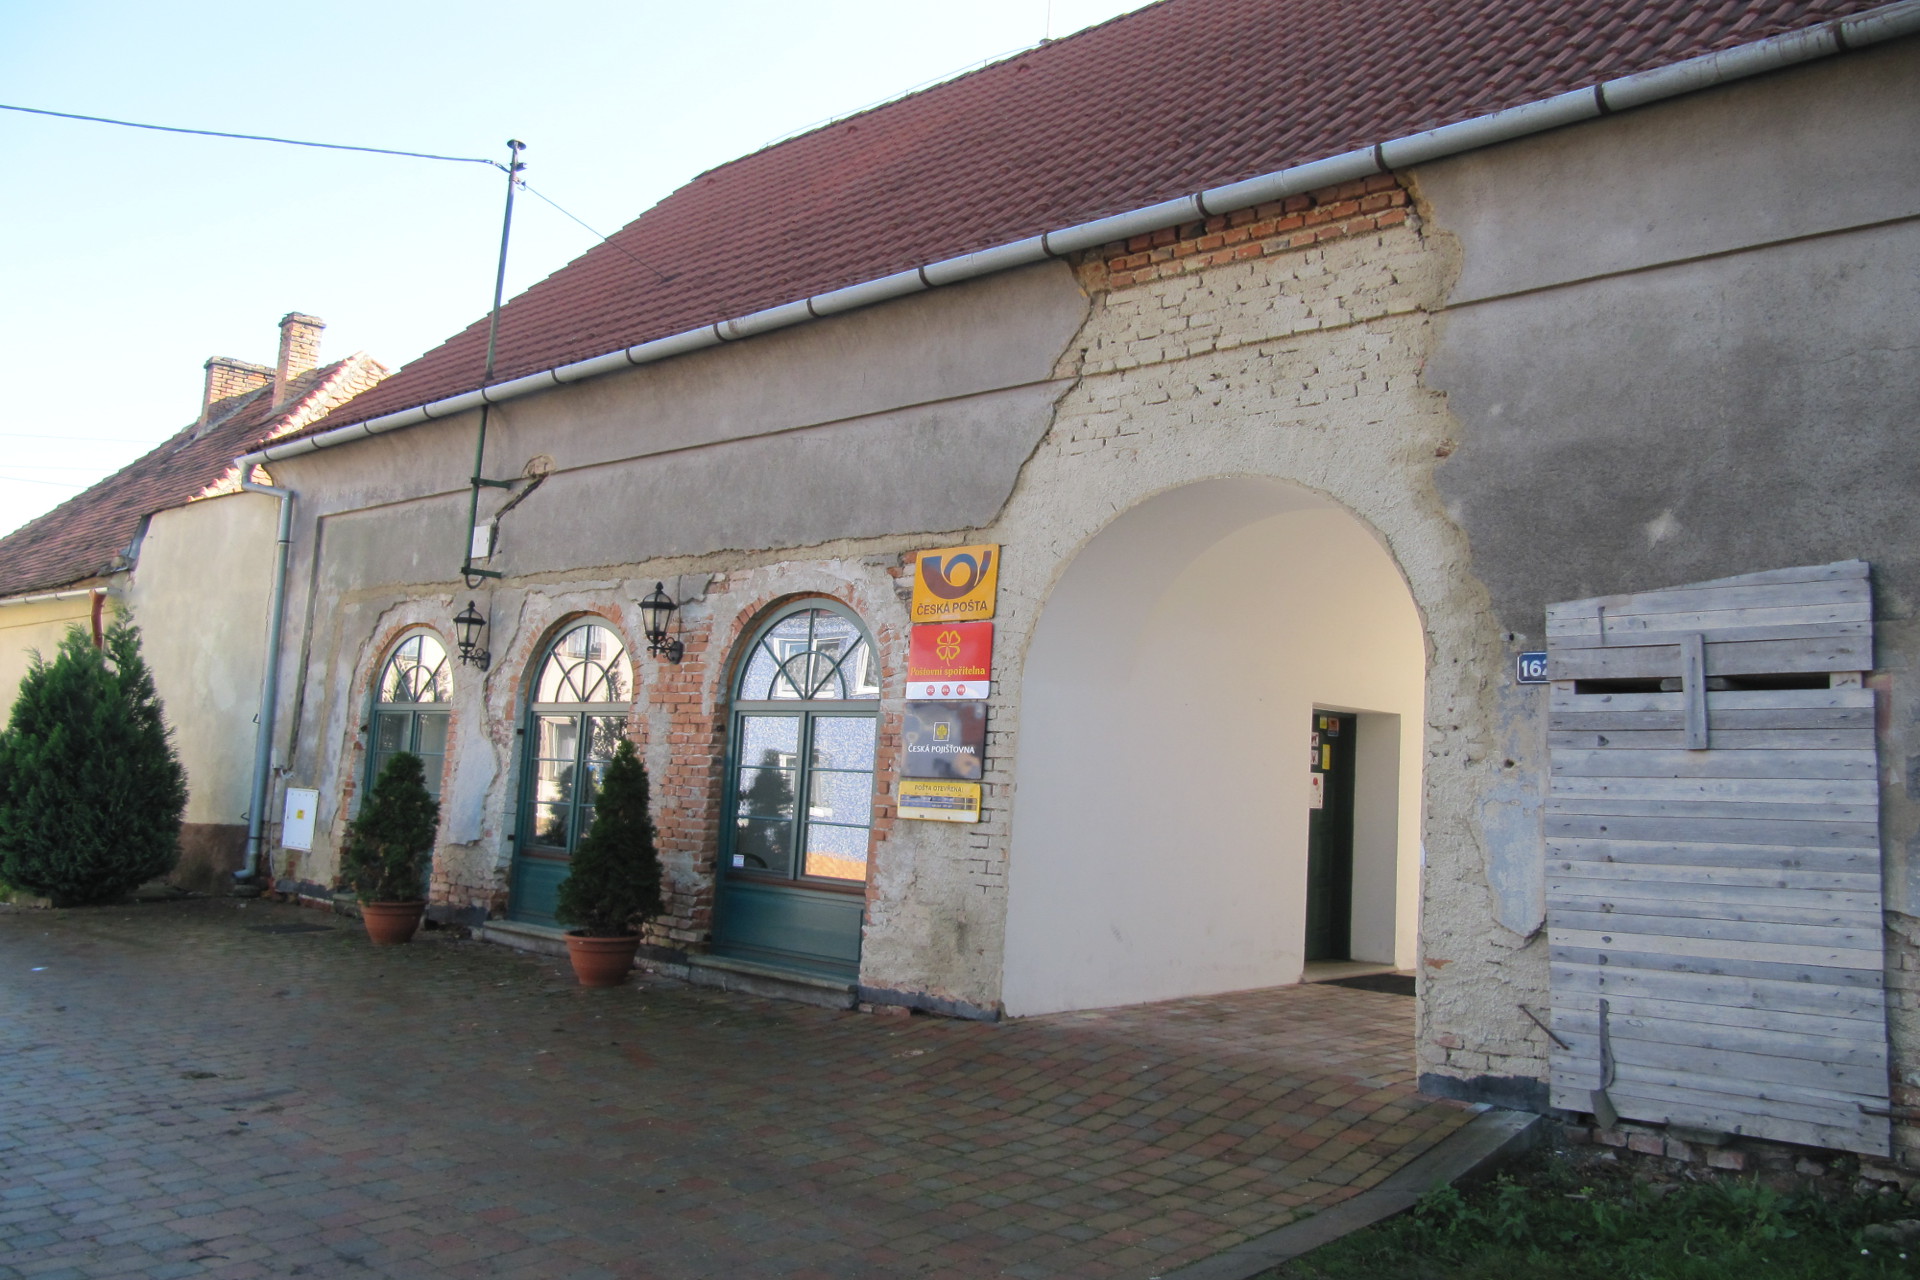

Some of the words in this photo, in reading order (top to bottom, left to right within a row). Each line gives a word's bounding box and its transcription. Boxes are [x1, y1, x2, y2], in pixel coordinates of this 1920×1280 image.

[917, 602, 950, 615] ČESKÁ
[952, 600, 988, 613] POŠTA
[911, 667, 942, 676] Poštovní
[944, 665, 986, 677] spořitelna
[908, 743, 930, 753] ČESKÁ
[931, 744, 975, 754] POJIŠŤOVNA
